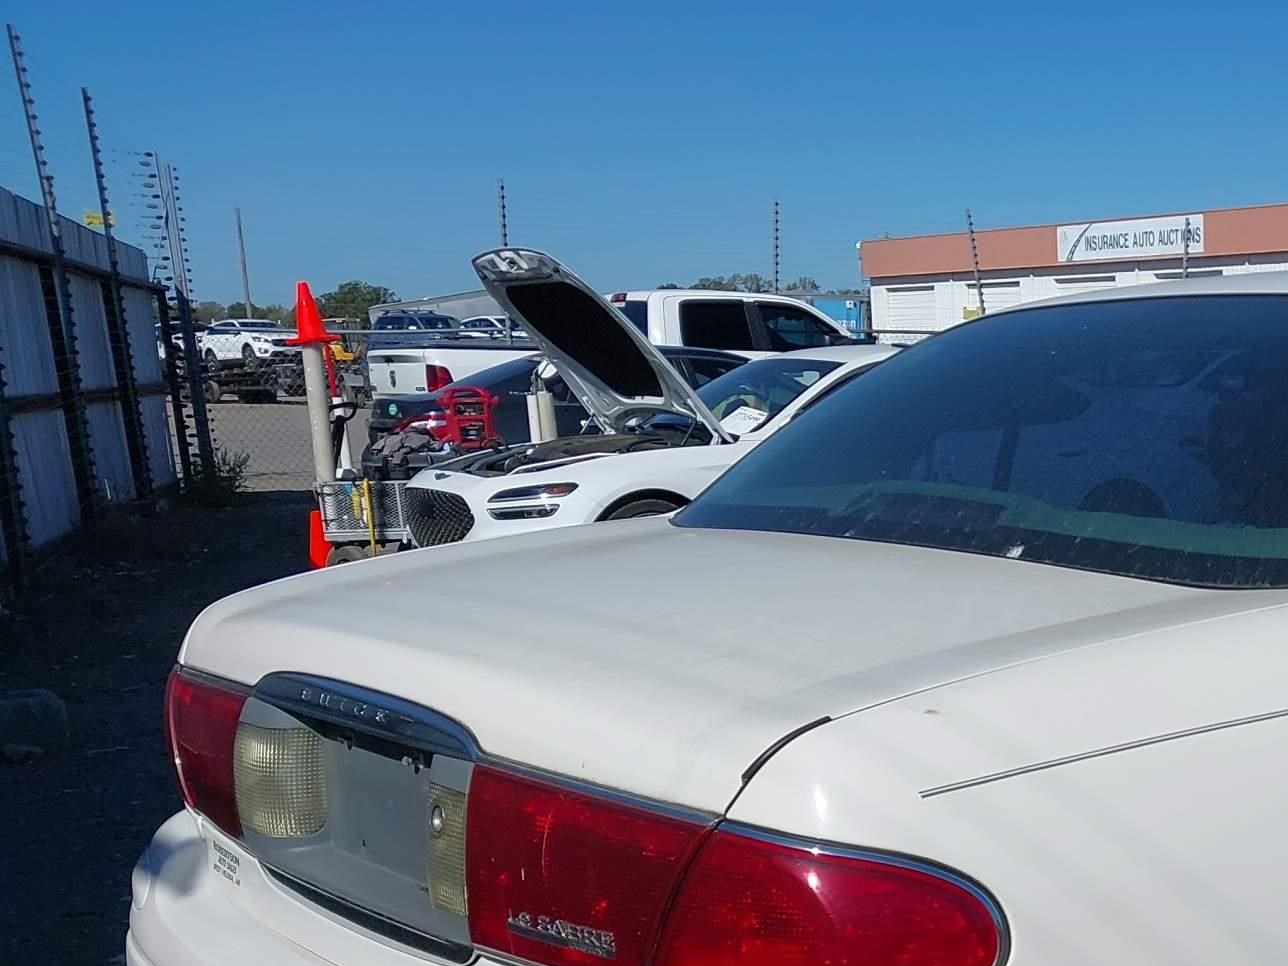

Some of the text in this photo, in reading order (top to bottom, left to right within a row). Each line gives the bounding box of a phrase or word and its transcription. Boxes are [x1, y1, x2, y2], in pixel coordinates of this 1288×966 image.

[1084, 232, 1129, 252] INSURANCE
[1132, 230, 1155, 249] AUTO
[301, 688, 390, 724] BUICK
[212, 839, 240, 868] ROBERTSON
